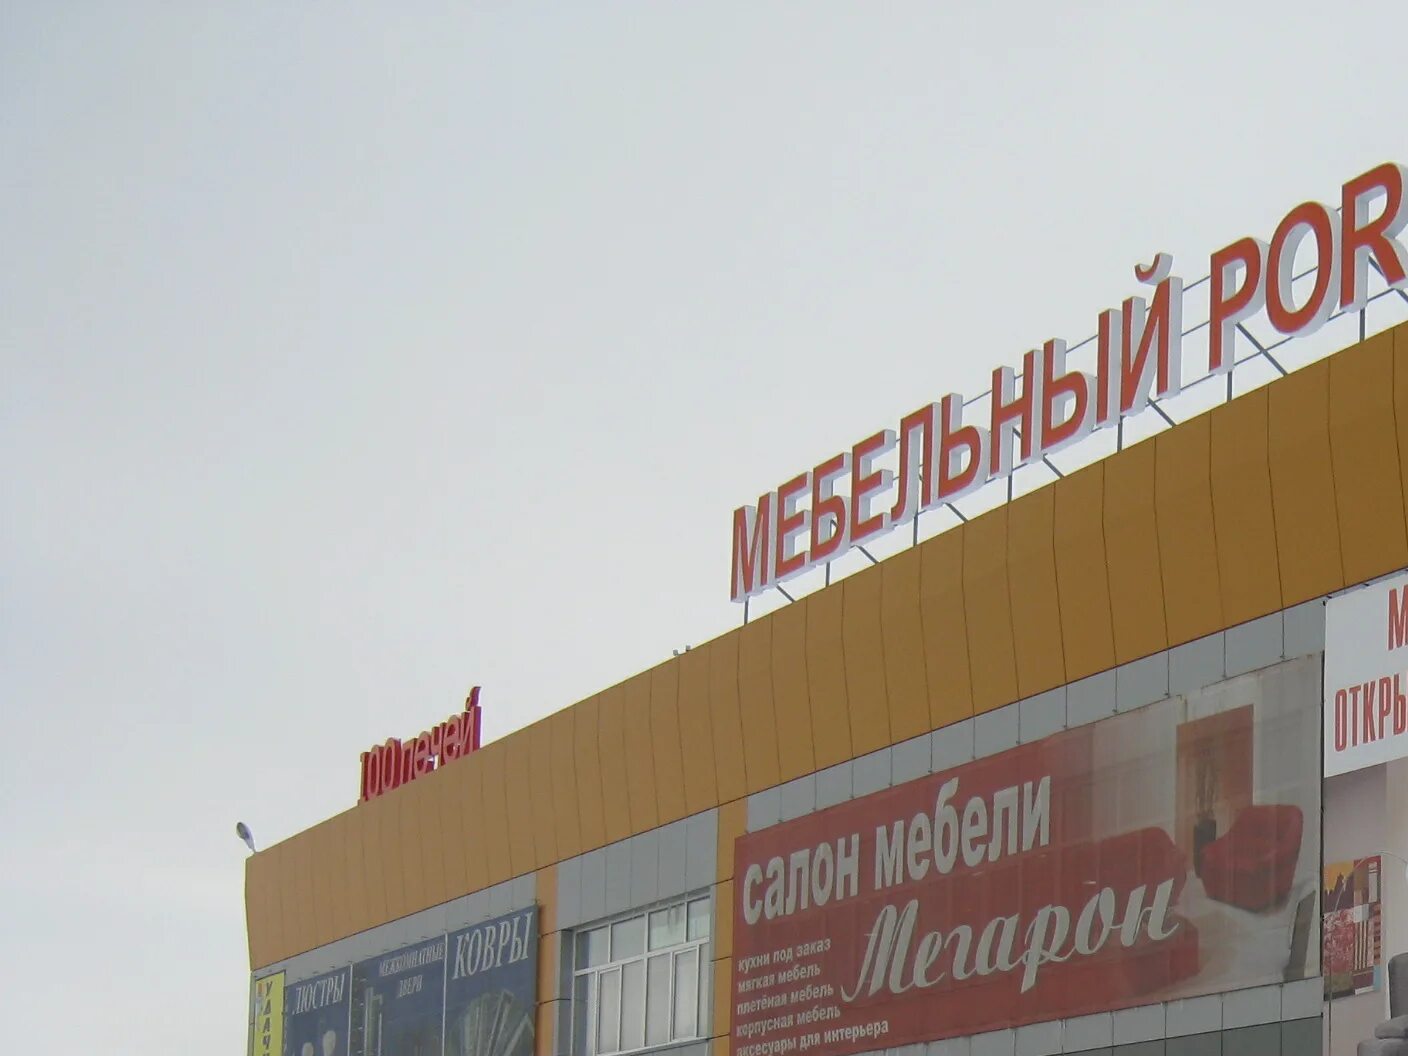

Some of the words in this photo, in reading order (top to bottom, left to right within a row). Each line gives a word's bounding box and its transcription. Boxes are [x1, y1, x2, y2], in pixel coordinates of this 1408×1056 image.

[730, 252, 1184, 603] МЕБЕЛЬНЫЙ
[742, 832, 860, 925] салон
[873, 775, 1051, 891] мебели
[453, 911, 533, 980] КОВРЫ
[738, 953, 770, 975] кухни
[773, 947, 793, 964] под
[796, 938, 832, 957] заказ
[841, 877, 1180, 1003] Мегарон
[292, 973, 345, 1016] ЛЮСТРЫ
[738, 974, 776, 993] мягкая
[778, 963, 821, 983] мебель
[737, 993, 787, 1016] плетёная
[790, 982, 834, 1004] мебель
[736, 1013, 794, 1038] корпусная
[797, 1004, 841, 1024] мебель
[800, 1032, 821, 1050] для
[824, 1019, 889, 1043] интерьера
